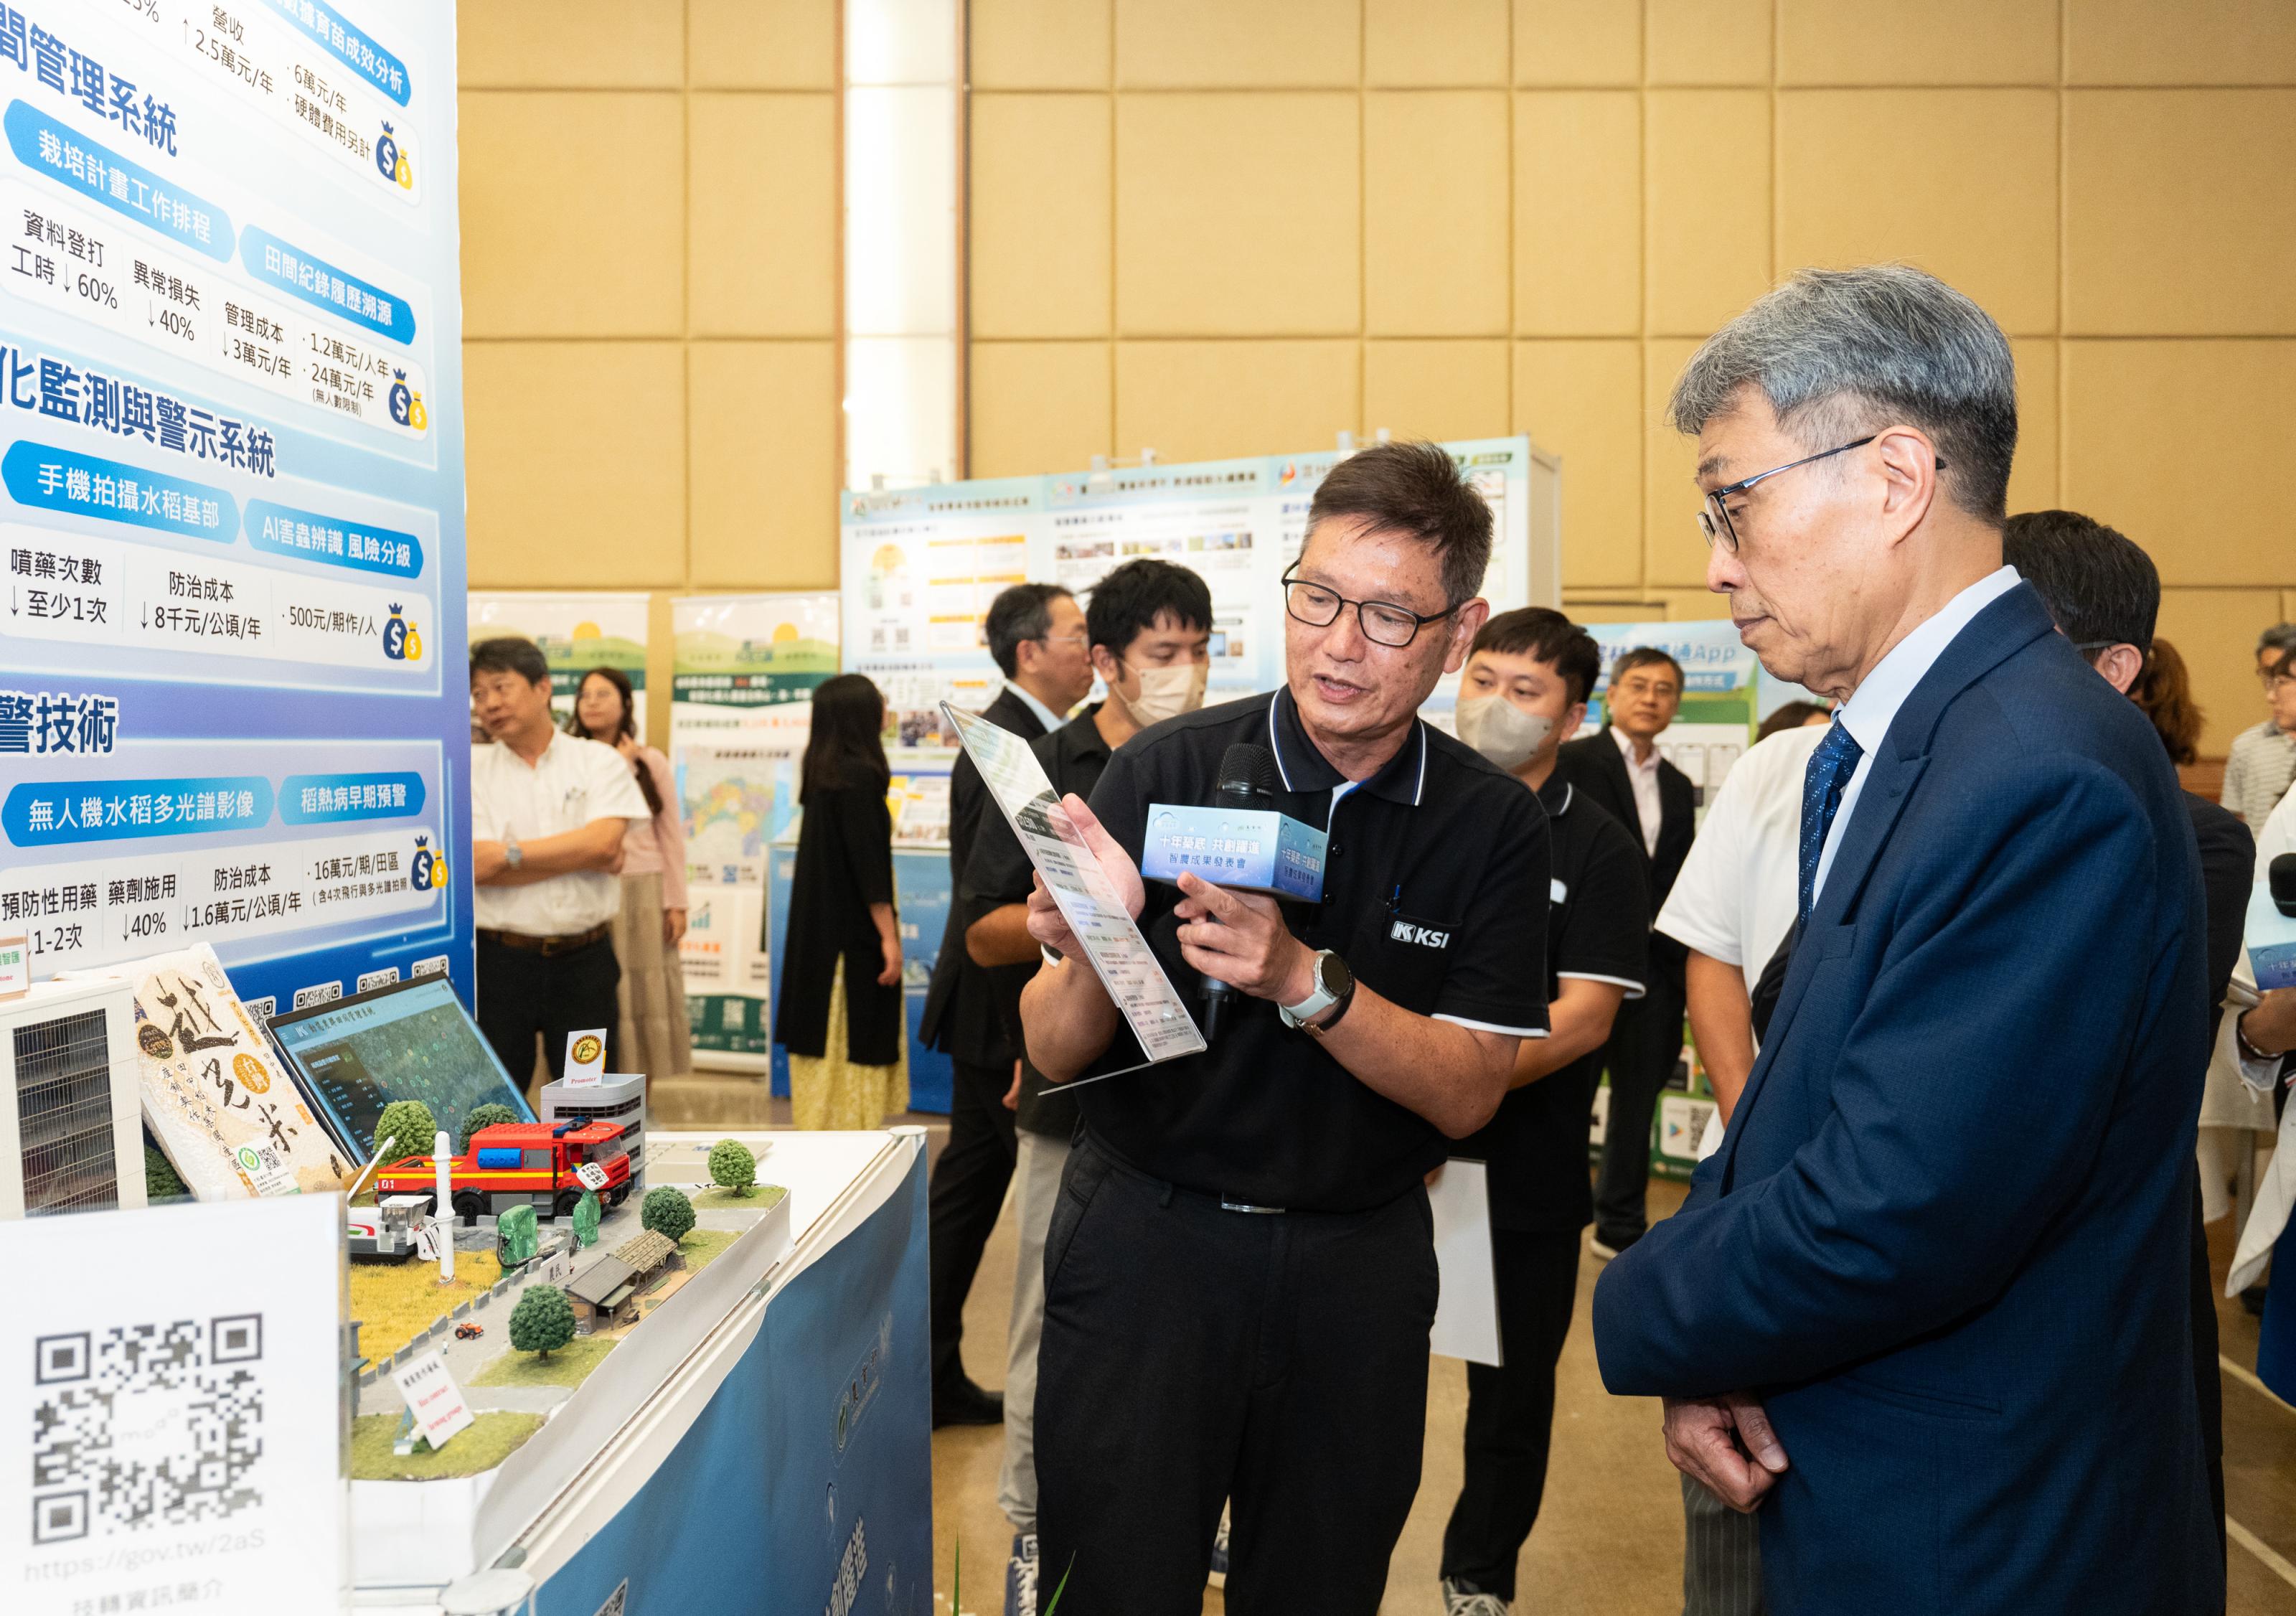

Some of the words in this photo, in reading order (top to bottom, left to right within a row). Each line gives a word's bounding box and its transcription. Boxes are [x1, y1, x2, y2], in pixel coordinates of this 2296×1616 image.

[212, 4, 245, 46] 營收
[195, 29, 273, 95] 2.5萬元/年
[295, 65, 347, 114] 6萬元/年
[295, 93, 371, 161] 硬體費用另計
[38, 129, 211, 244] 栽培計畫工作排程
[24, 210, 104, 268] 資料登打
[11, 244, 55, 286] 工時
[78, 273, 118, 310] 60%
[134, 259, 201, 311] 異常損失
[265, 245, 392, 326] 田間紀錄履歷溯源
[159, 309, 195, 342] 40%
[225, 301, 283, 344] 管理成本
[233, 339, 292, 379] 3萬元/年
[310, 333, 389, 379] 1.2萬元/人年
[311, 363, 375, 402] 24萬元/年
[0, 345, 276, 479] 化監測與警示系統
[37, 464, 220, 530] 手機拍攝水稻基部
[263, 516, 344, 557] AI害蟲辨識
[347, 532, 411, 568] 風險分級
[11, 548, 102, 586] 噴藥次數
[27, 589, 107, 624] 至少1次
[169, 571, 234, 603] 防治成本
[155, 606, 262, 640] 8千元/公頃/年
[289, 606, 377, 636] 500元/期作/人
[0, 695, 116, 754] 警技術
[29, 790, 254, 832] 無人機水稻多光譜影像
[301, 783, 407, 814] 稻熱病早期預警
[214, 863, 271, 892] 防治成本
[315, 851, 400, 880] 16萬元/期/田區
[1, 883, 97, 921] 預防性用藥
[108, 874, 176, 906] 藥劑施用
[131, 911, 166, 937] 40%
[192, 891, 302, 929] 1.6萬元/公頃/年
[34, 923, 83, 954] 1-2次
[1413, 926, 1450, 949] KSI
[381, 1179, 395, 1189] 01
